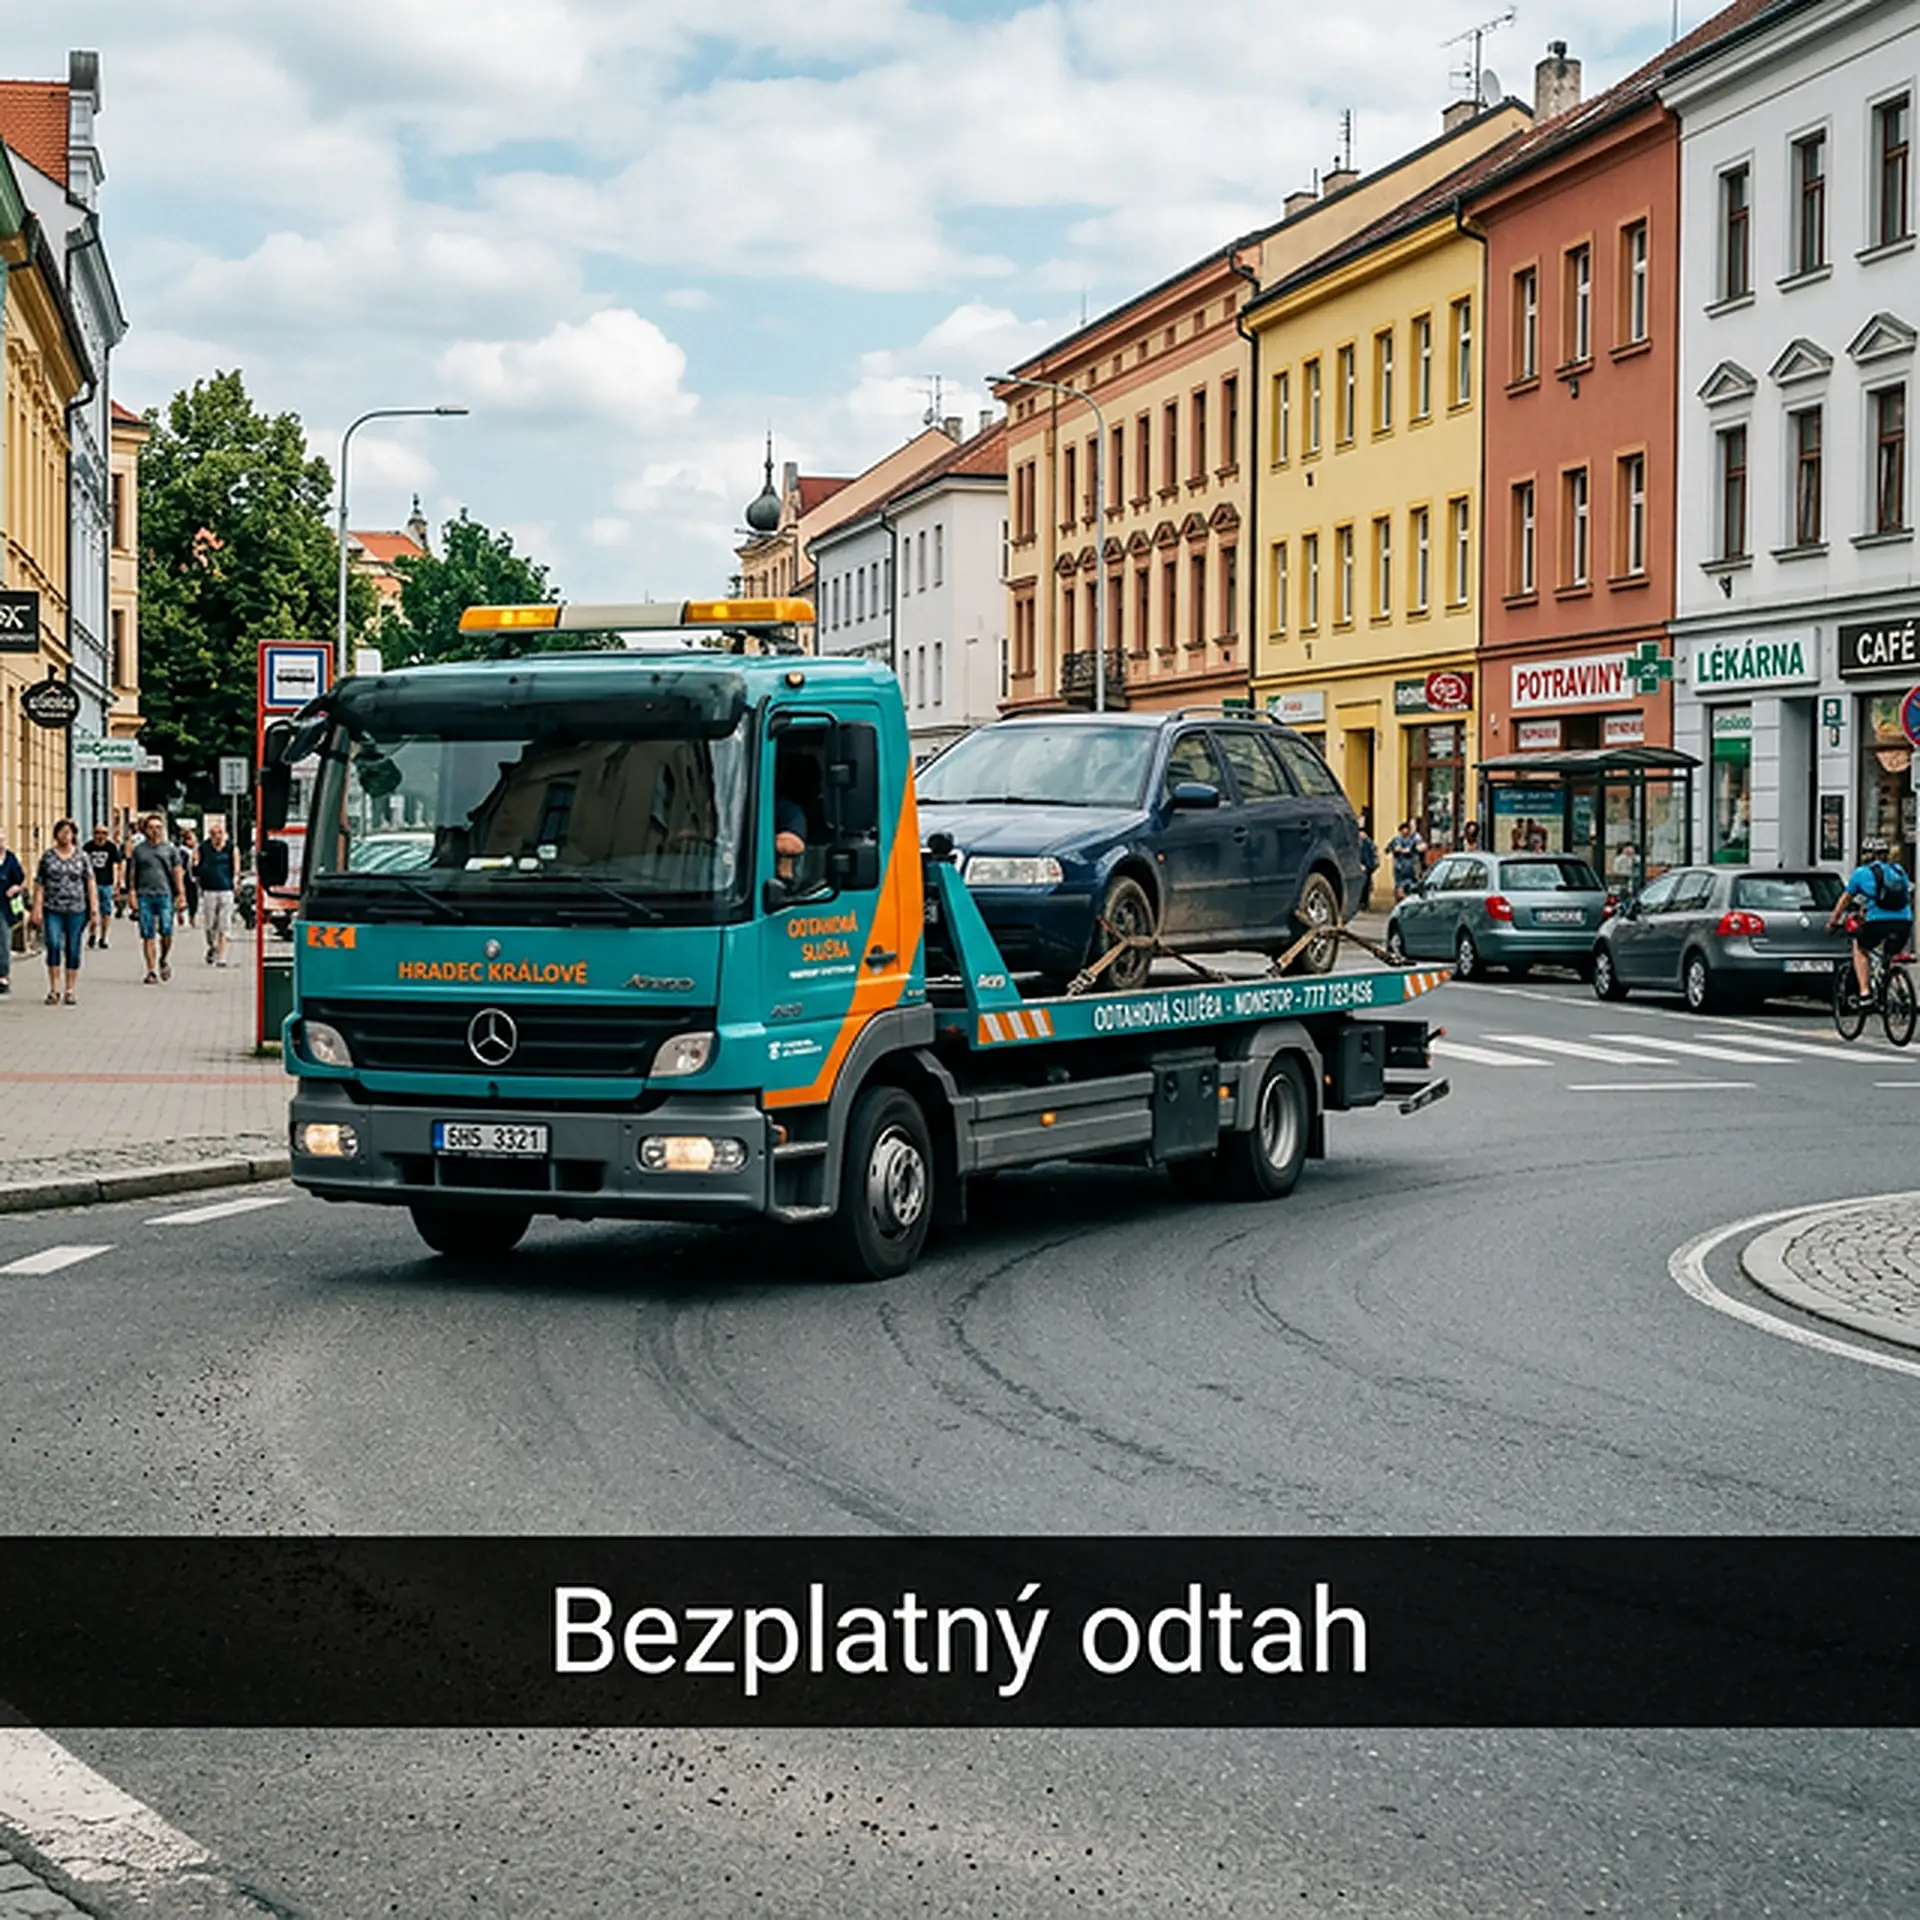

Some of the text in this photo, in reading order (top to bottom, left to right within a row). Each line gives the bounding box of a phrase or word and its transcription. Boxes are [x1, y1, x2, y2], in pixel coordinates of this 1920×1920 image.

[1697, 638, 1804, 683] LÉKÁRNA
[1856, 620, 1916, 664] CAFÉ
[1516, 661, 1624, 701] POTRAVINY
[398, 957, 588, 985] HRADEC KRÁLOVÉ
[493, 1128, 538, 1150] 3321
